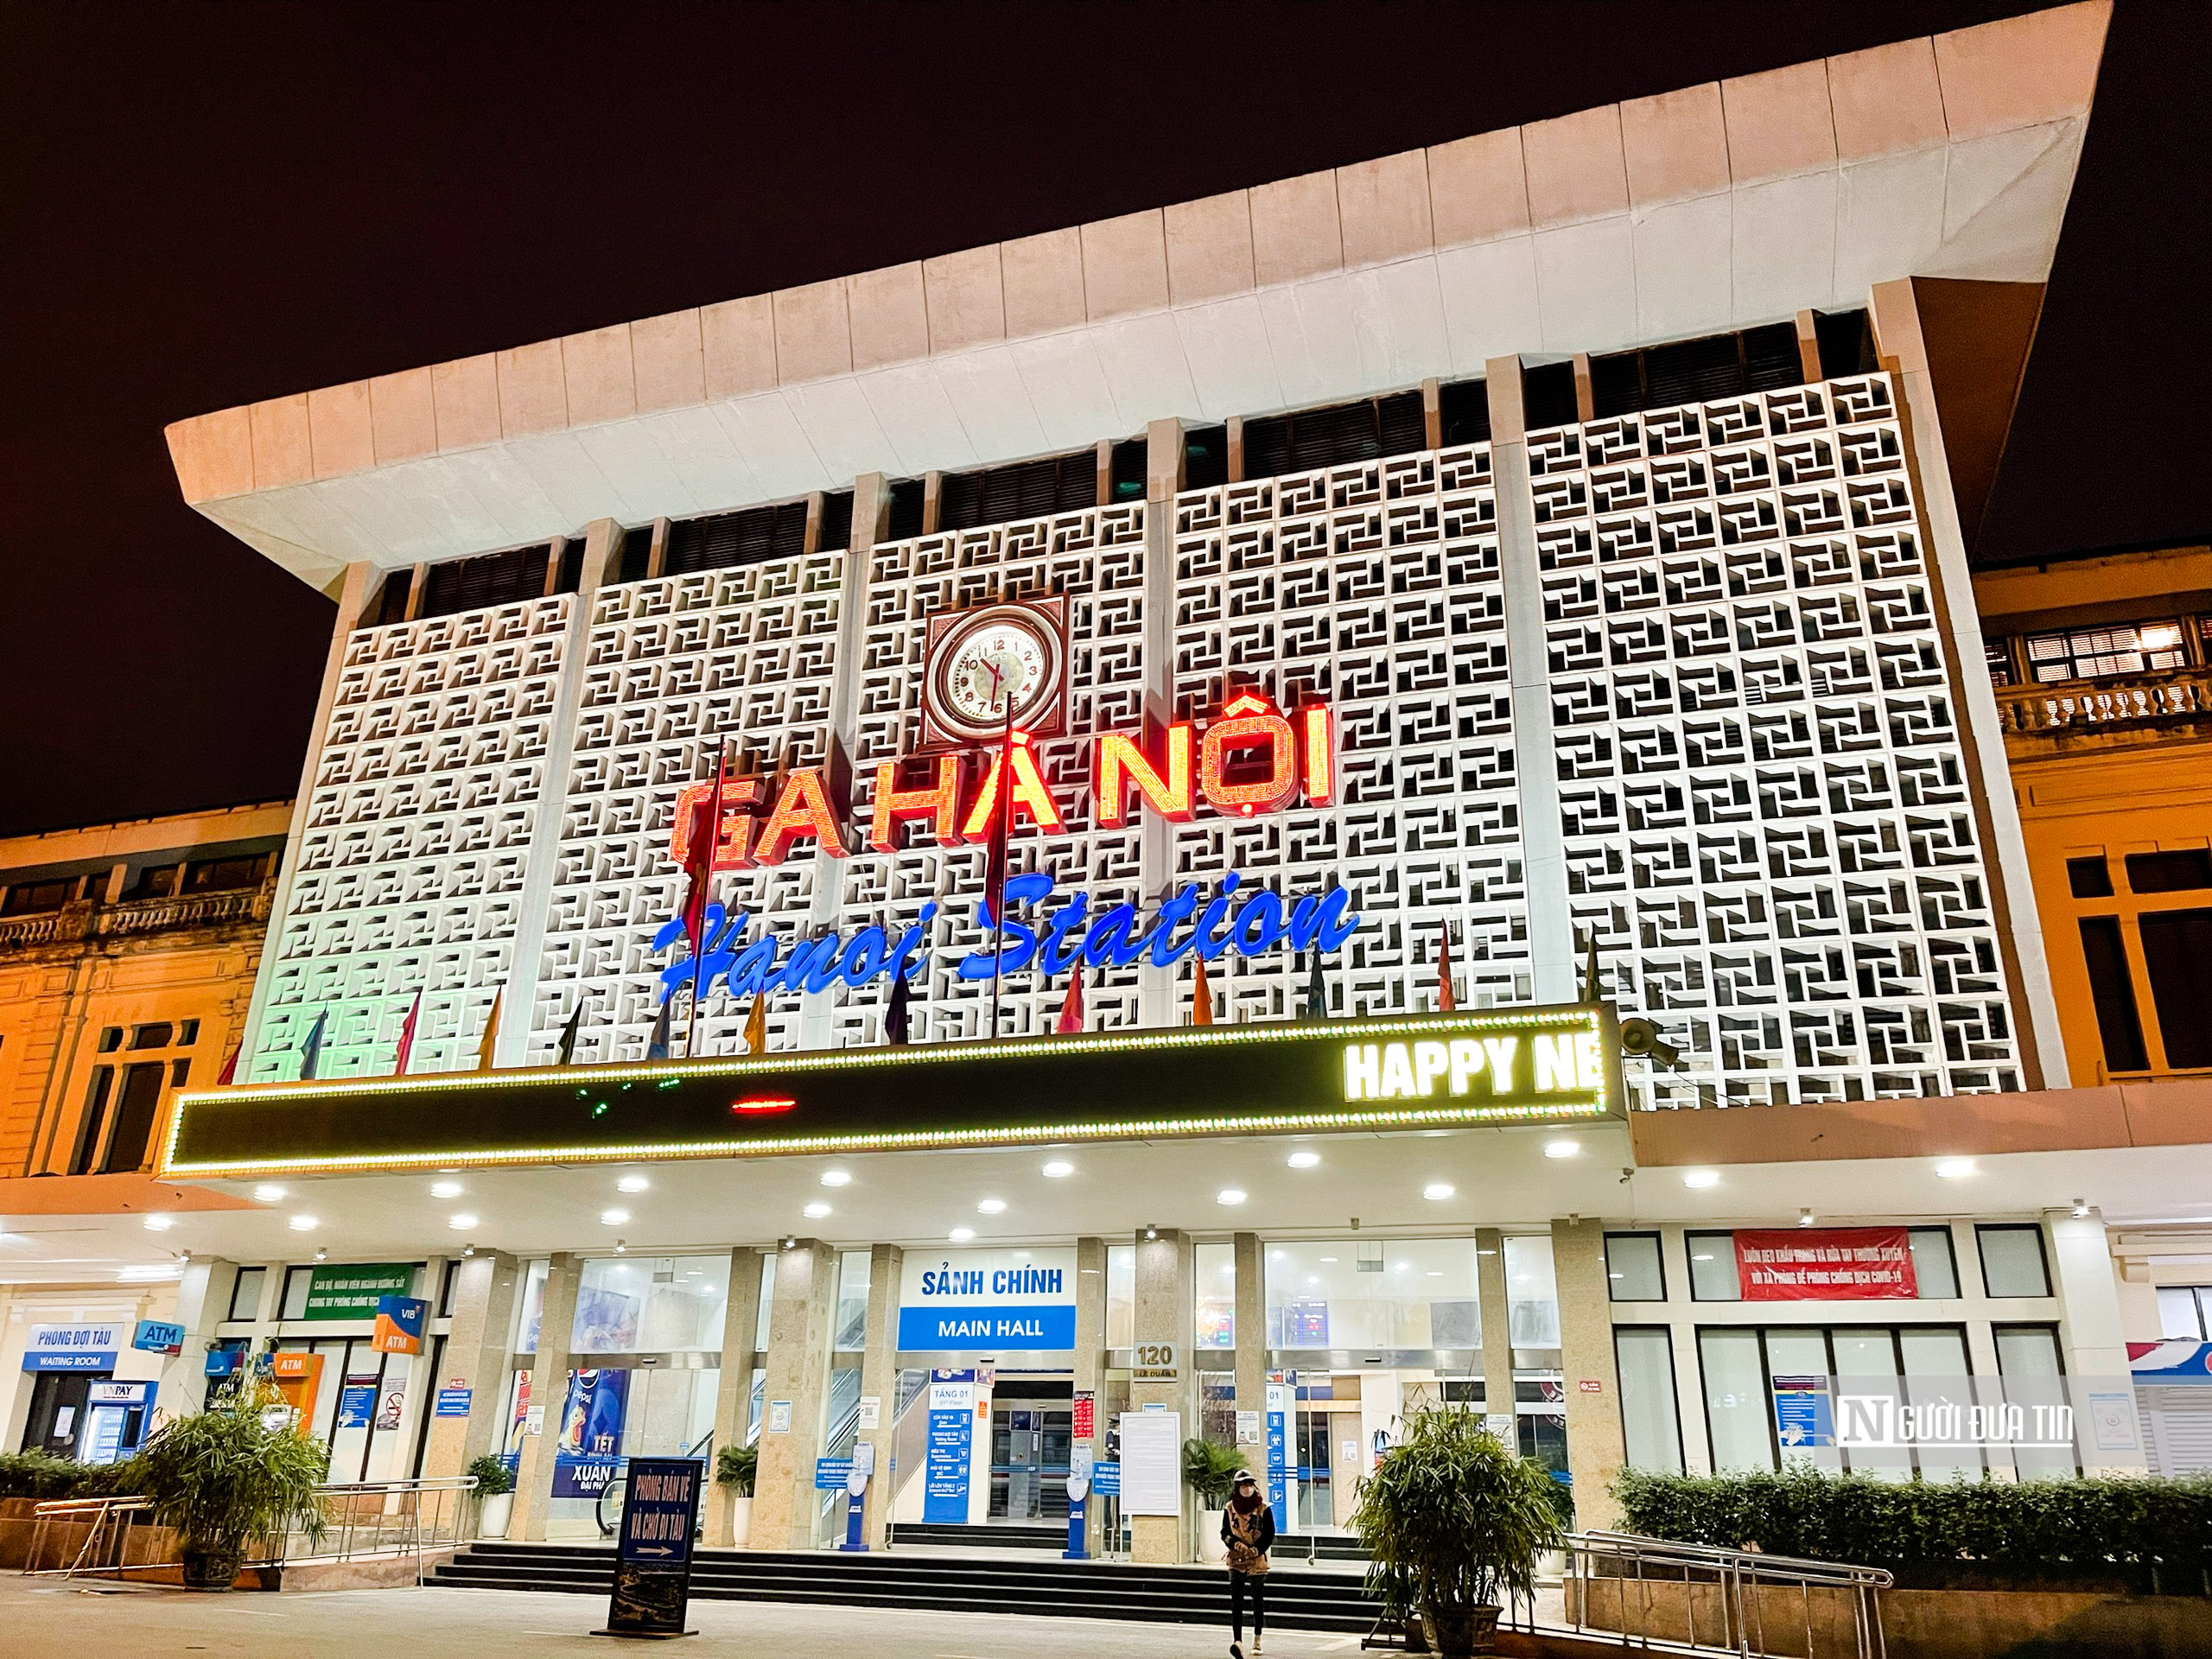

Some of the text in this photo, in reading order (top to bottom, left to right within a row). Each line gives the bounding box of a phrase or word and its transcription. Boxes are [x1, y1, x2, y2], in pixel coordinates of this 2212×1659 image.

[995, 639, 1005, 651] 12
[1025, 652, 1033, 661] 2
[964, 660, 978, 671] 10
[1029, 666, 1038, 676] 3
[960, 677, 969, 687] 9
[1023, 683, 1032, 692] 4
[964, 692, 974, 702] 8
[978, 702, 986, 713] 7
[995, 703, 1002, 714] 6
[671, 694, 1333, 868] GA HÀ NỘI
[652, 871, 1360, 1002] Hanoi Station
[1344, 1037, 1517, 1102] HAPPY
[921, 1262, 1062, 1295] SẢNH CHÍNH
[401, 1309, 416, 1319] VIB
[144, 1325, 177, 1343] ATM
[938, 1319, 1044, 1337] MAIN HALL
[73, 1330, 90, 1349] ĐỢI
[92, 1326, 111, 1345] TÀU
[385, 1336, 408, 1349] ATM
[1138, 1345, 1172, 1365] 120
[40, 1357, 101, 1366] WAITING ROOM
[281, 1359, 302, 1370] ATM
[103, 1385, 133, 1395] VNPAY
[1269, 1391, 1279, 1400] 01
[573, 1389, 592, 1404] pepsi
[594, 1431, 614, 1452] TẾT
[572, 1461, 611, 1481] XUÂN
[635, 1468, 691, 1502] PHÒNG BÁN VÉ
[631, 1507, 686, 1541] VÀ CHỜ ĐI TÀU
